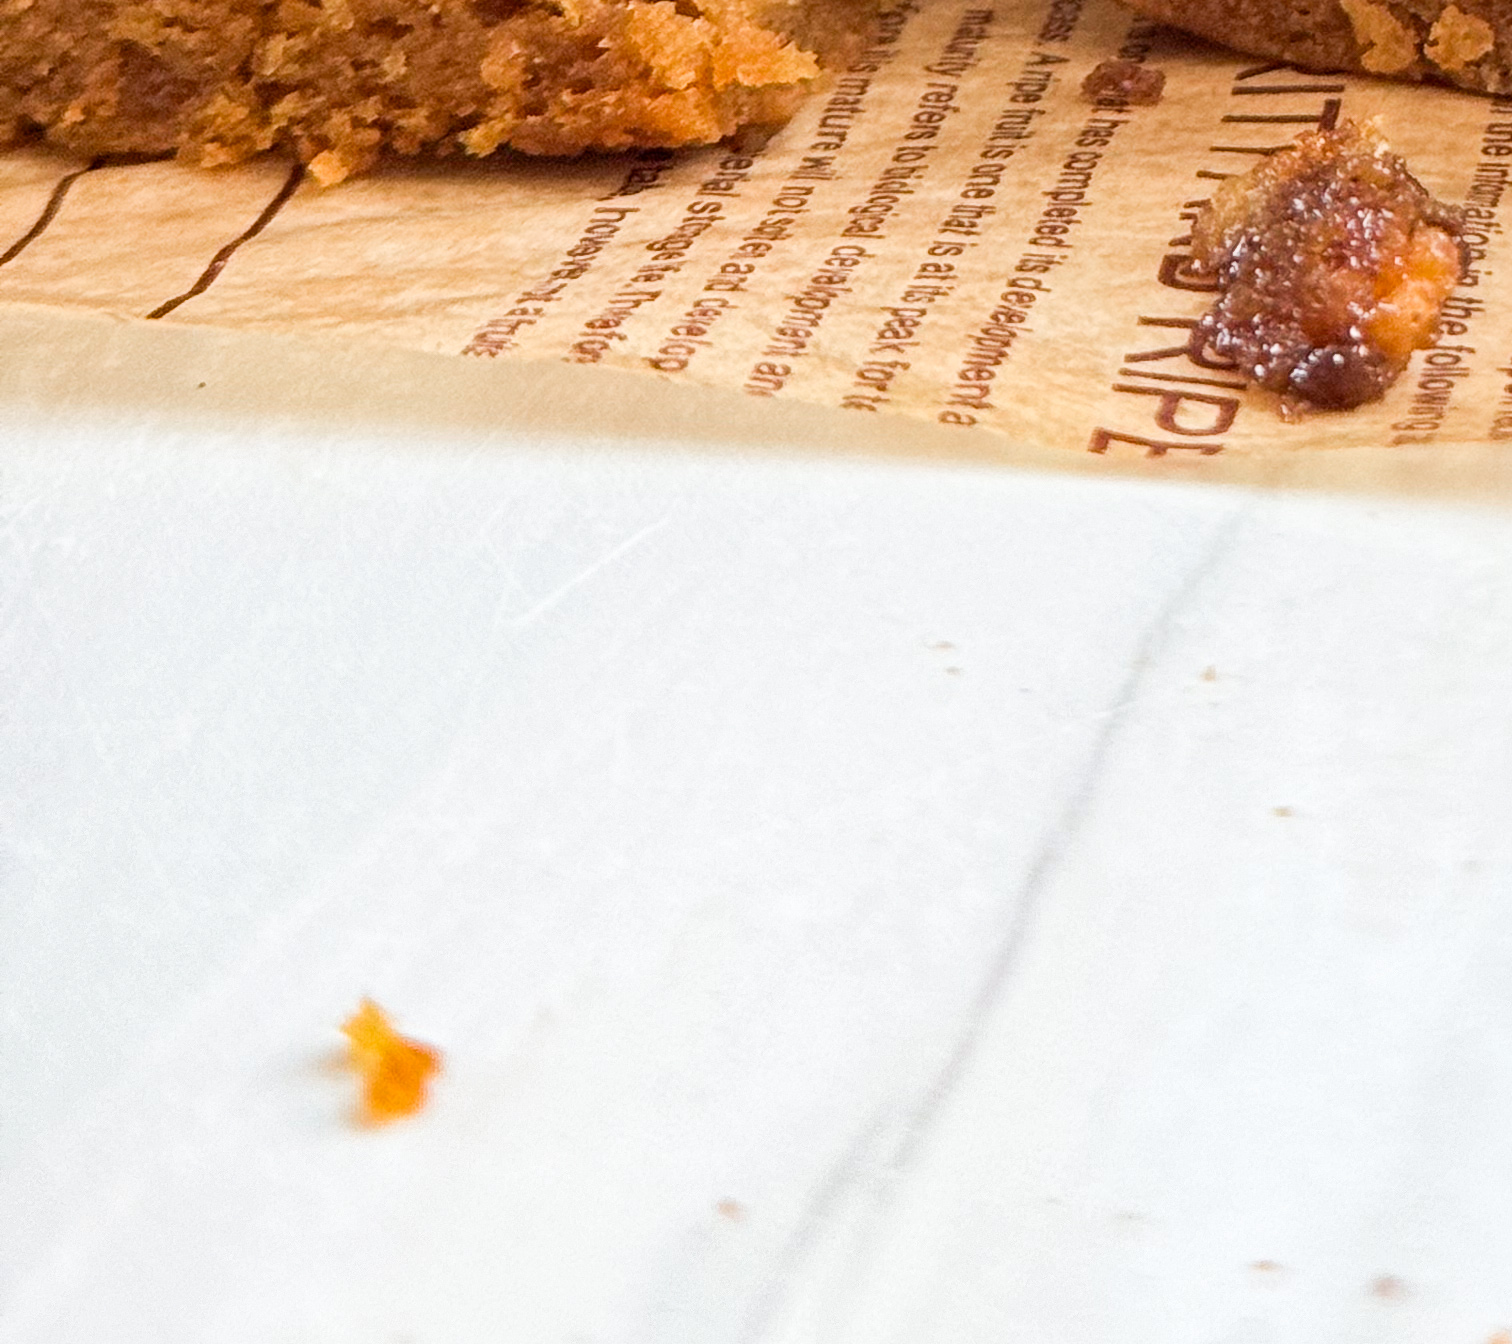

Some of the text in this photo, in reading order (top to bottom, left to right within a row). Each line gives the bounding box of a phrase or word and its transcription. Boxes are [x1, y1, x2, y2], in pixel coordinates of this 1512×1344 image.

[923, 9, 994, 78] maturity
[1031, 50, 1071, 65] A
[1006, 69, 1061, 103] ripe
[810, 77, 872, 151] mature
[905, 82, 961, 141] refers
[988, 108, 1046, 141] fruit
[1208, 64, 1344, 155] ITY
[1076, 116, 1133, 147] has
[788, 155, 843, 180] will
[892, 144, 938, 163] to
[980, 143, 1027, 159] is
[960, 163, 1006, 198] one
[767, 185, 816, 216] not
[841, 164, 929, 239] biological
[1028, 151, 1103, 248] completed
[938, 204, 996, 235] that
[927, 240, 979, 256] is
[1015, 252, 1069, 274] its
[914, 262, 959, 280] at
[763, 244, 875, 357] development
[900, 283, 955, 304] its
[870, 306, 928, 353] peak
[1439, 295, 1485, 336] the
[640, 297, 738, 372] develop
[946, 276, 1052, 410] development
[854, 360, 910, 391] for
[1391, 344, 1476, 431] following
